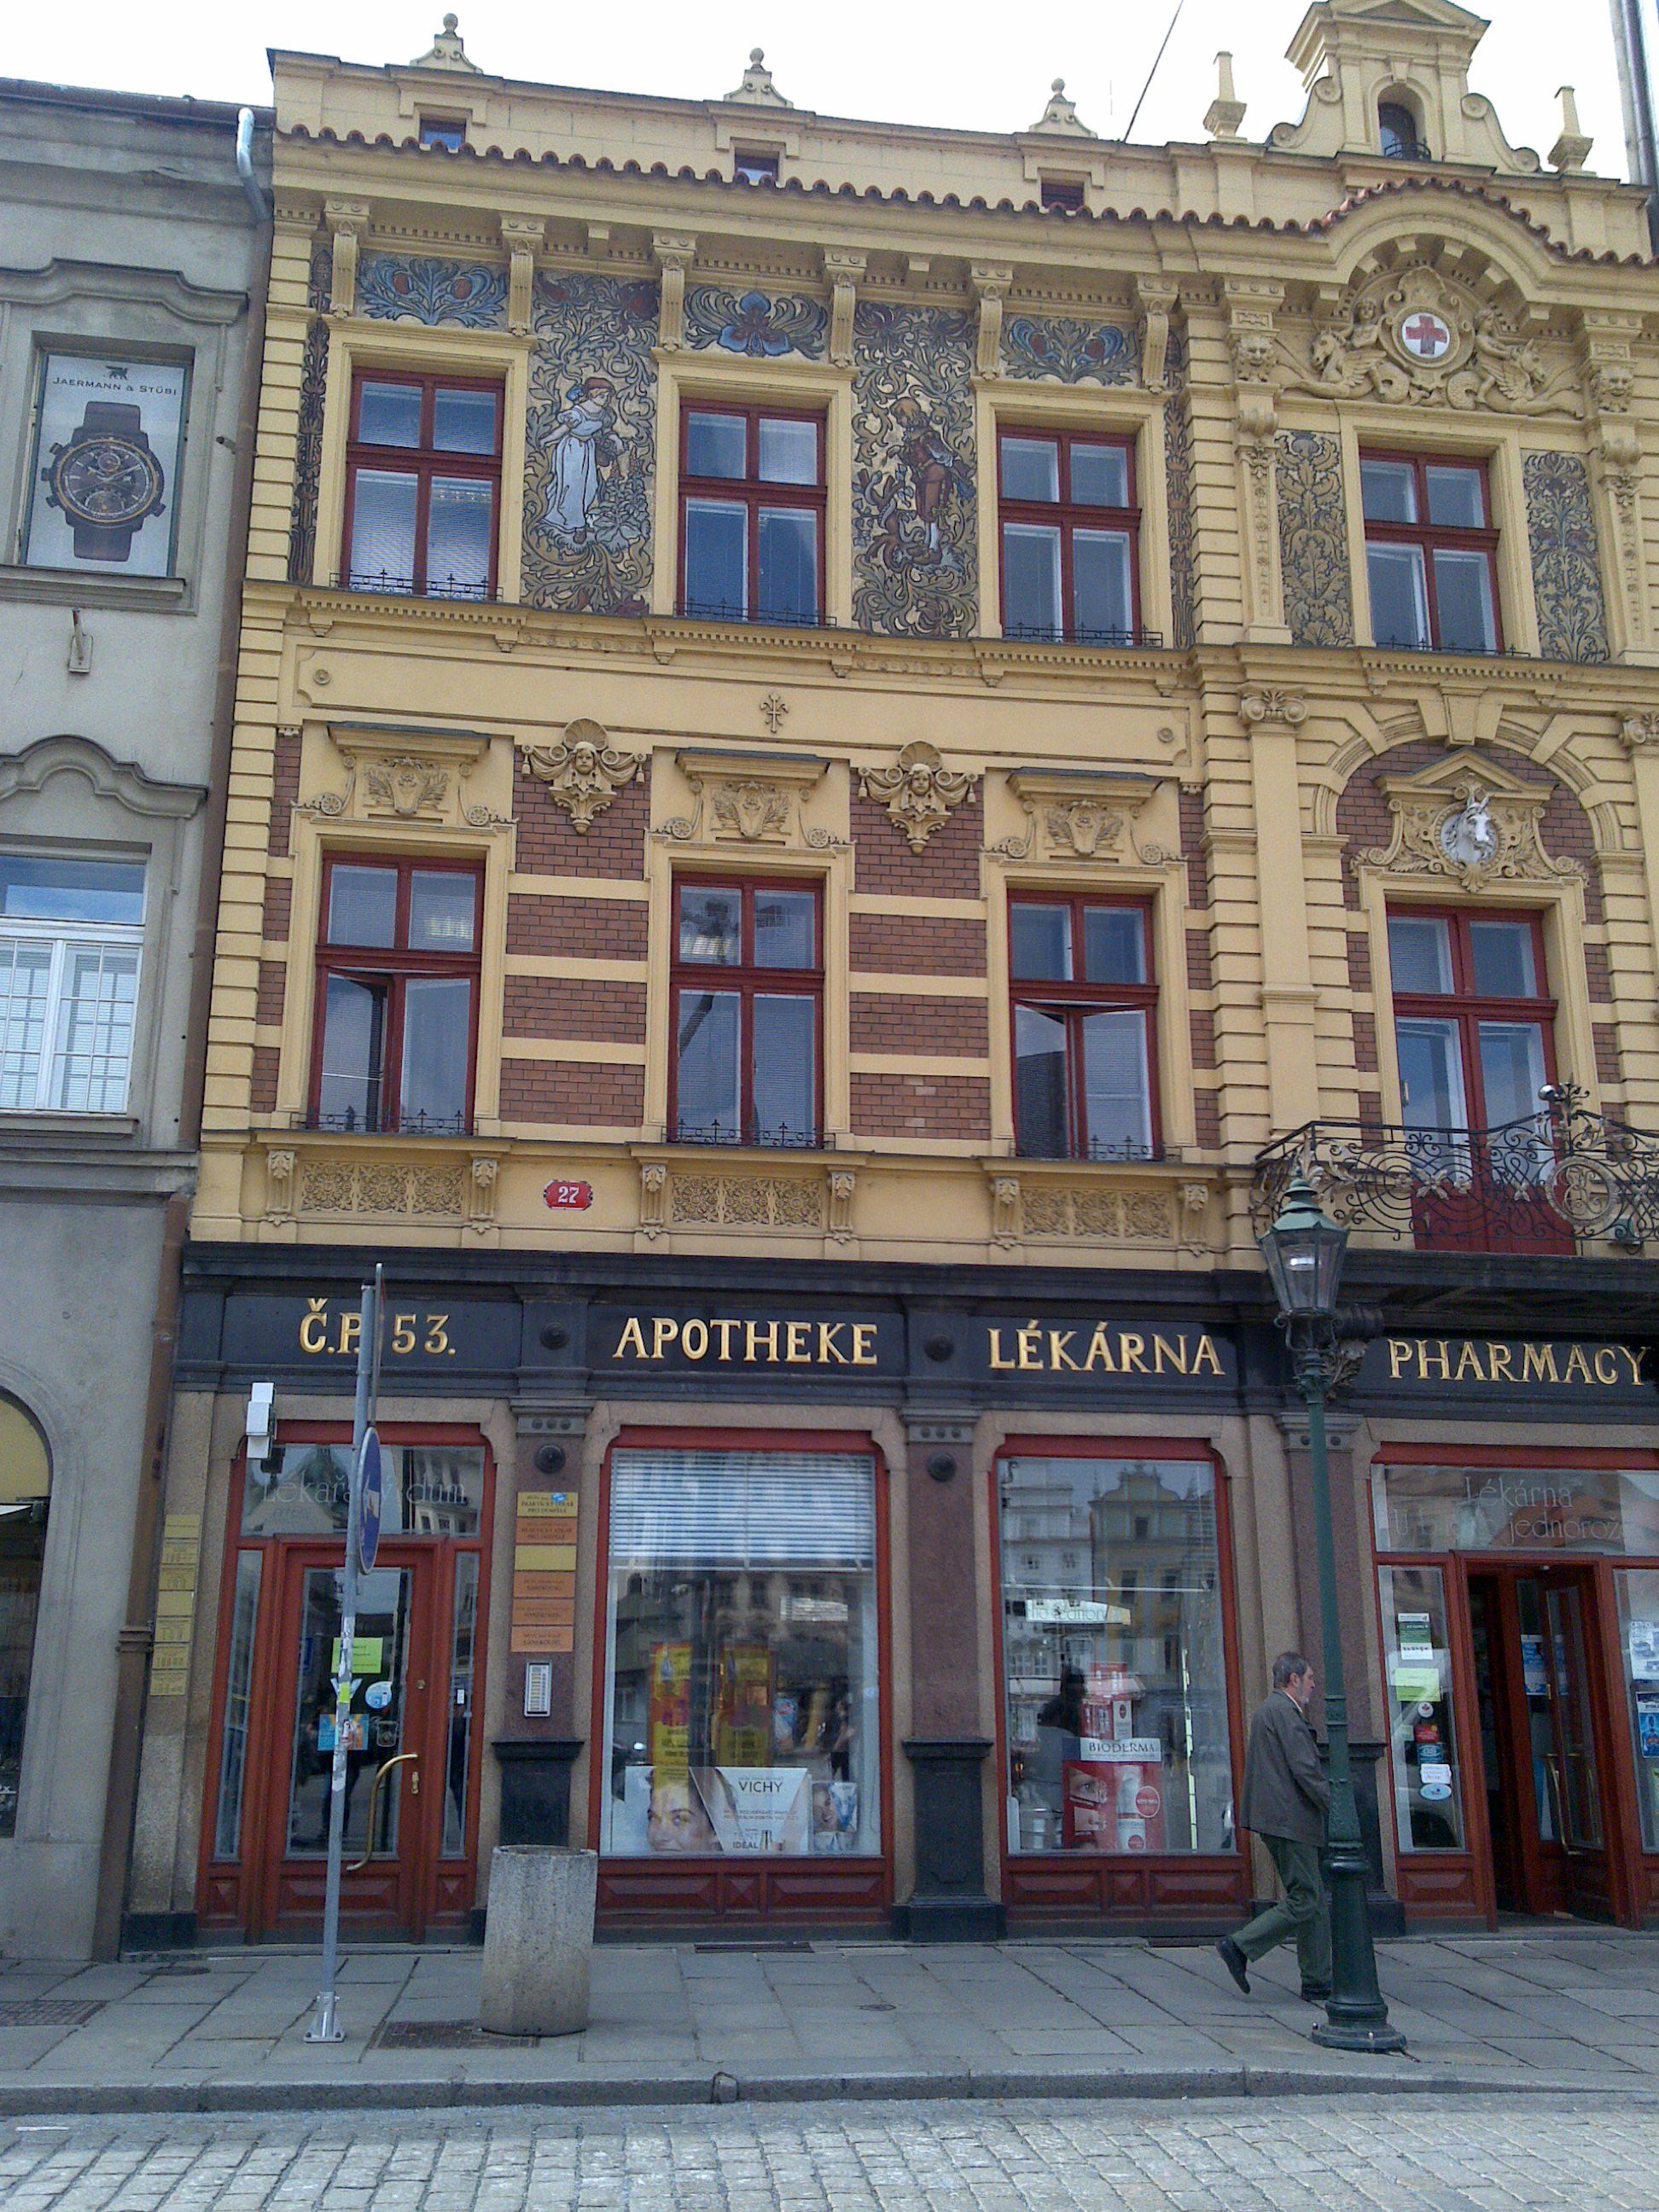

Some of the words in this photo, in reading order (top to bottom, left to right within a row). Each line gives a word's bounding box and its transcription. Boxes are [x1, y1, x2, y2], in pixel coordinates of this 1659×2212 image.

[52, 377, 121, 391] JAERMANN
[139, 384, 178, 396] STÜBI
[557, 1185, 579, 1204] 27
[392, 1313, 457, 1356] 53.
[612, 1315, 880, 1366] APOTHEKE
[987, 1318, 1226, 1377] LÉKÁRNA
[1387, 1337, 1648, 1388] PHARMACY
[405, 1471, 466, 1505] dům
[1463, 1476, 1574, 1509] Lékárna
[1089, 1741, 1155, 1754] BIODERMA
[738, 1780, 783, 1794] VICHY
